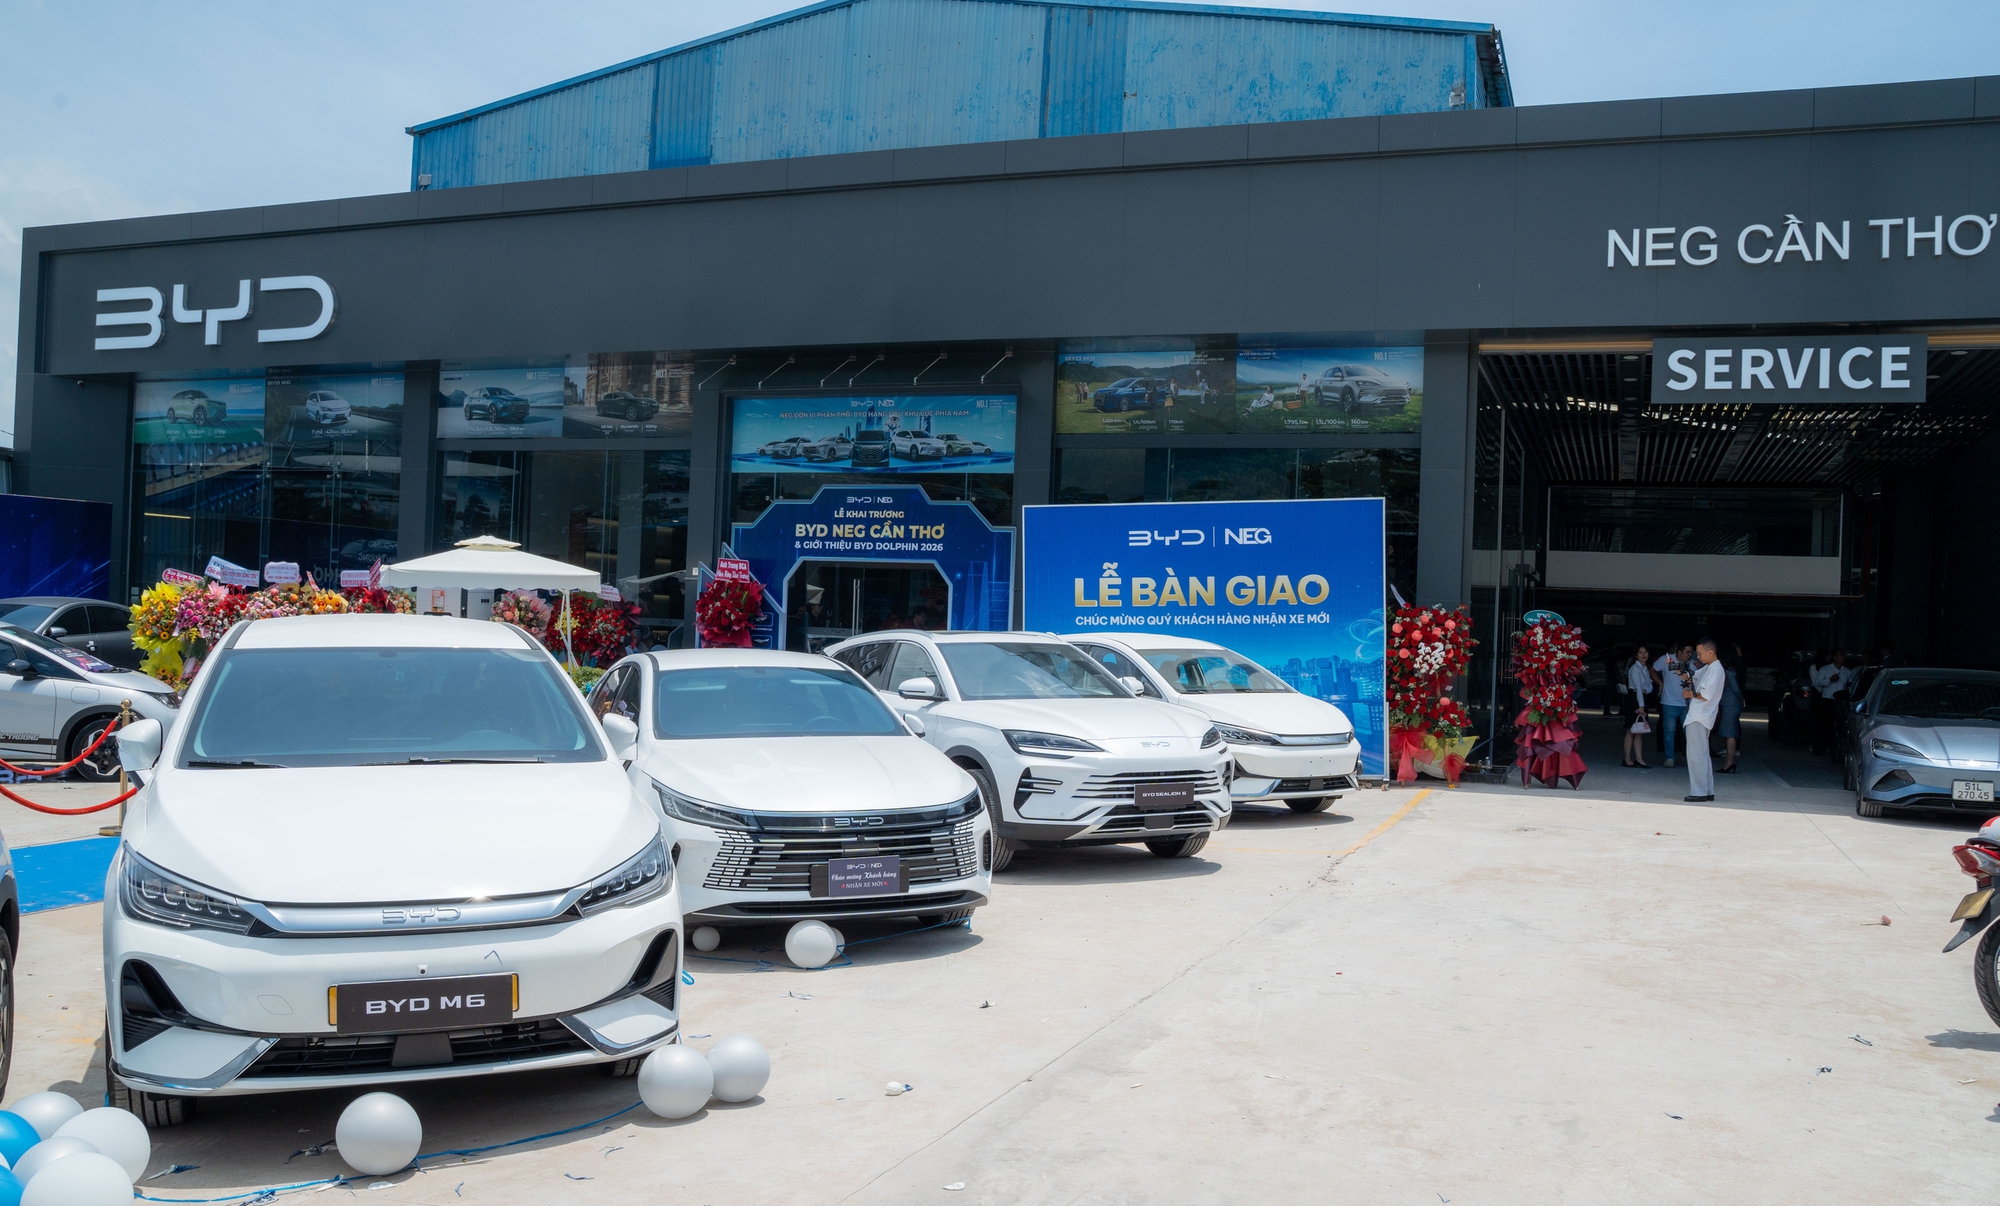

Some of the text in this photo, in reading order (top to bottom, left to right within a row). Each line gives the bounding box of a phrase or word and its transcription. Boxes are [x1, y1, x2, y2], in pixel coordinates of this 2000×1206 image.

[1607, 213, 1998, 268] NEG CẦN THƠ
[94, 275, 336, 350] BYD
[1666, 345, 1911, 391] SERVICE
[878, 399, 895, 407] NEG
[834, 507, 905, 519] LỄ KHAI TRƯƠNG
[795, 520, 945, 539] BYD NEG CẦN THƠ
[1128, 527, 1272, 546] BYD NEG
[794, 539, 944, 551] & GIỚI THIỆU BYD DOLPHIN 2026
[1074, 562, 1330, 607] LỄ BÀN GIAO
[1075, 611, 1330, 627] CHÚC MỪNG QUÝ KHÁCH HÀNG NHẬN XE MỚI
[1957, 791, 1989, 800] 270.45
[1965, 783, 1982, 791] 51L
[834, 816, 884, 828] BYD
[382, 906, 462, 925] BYD
[366, 993, 486, 1014] BYD M6
